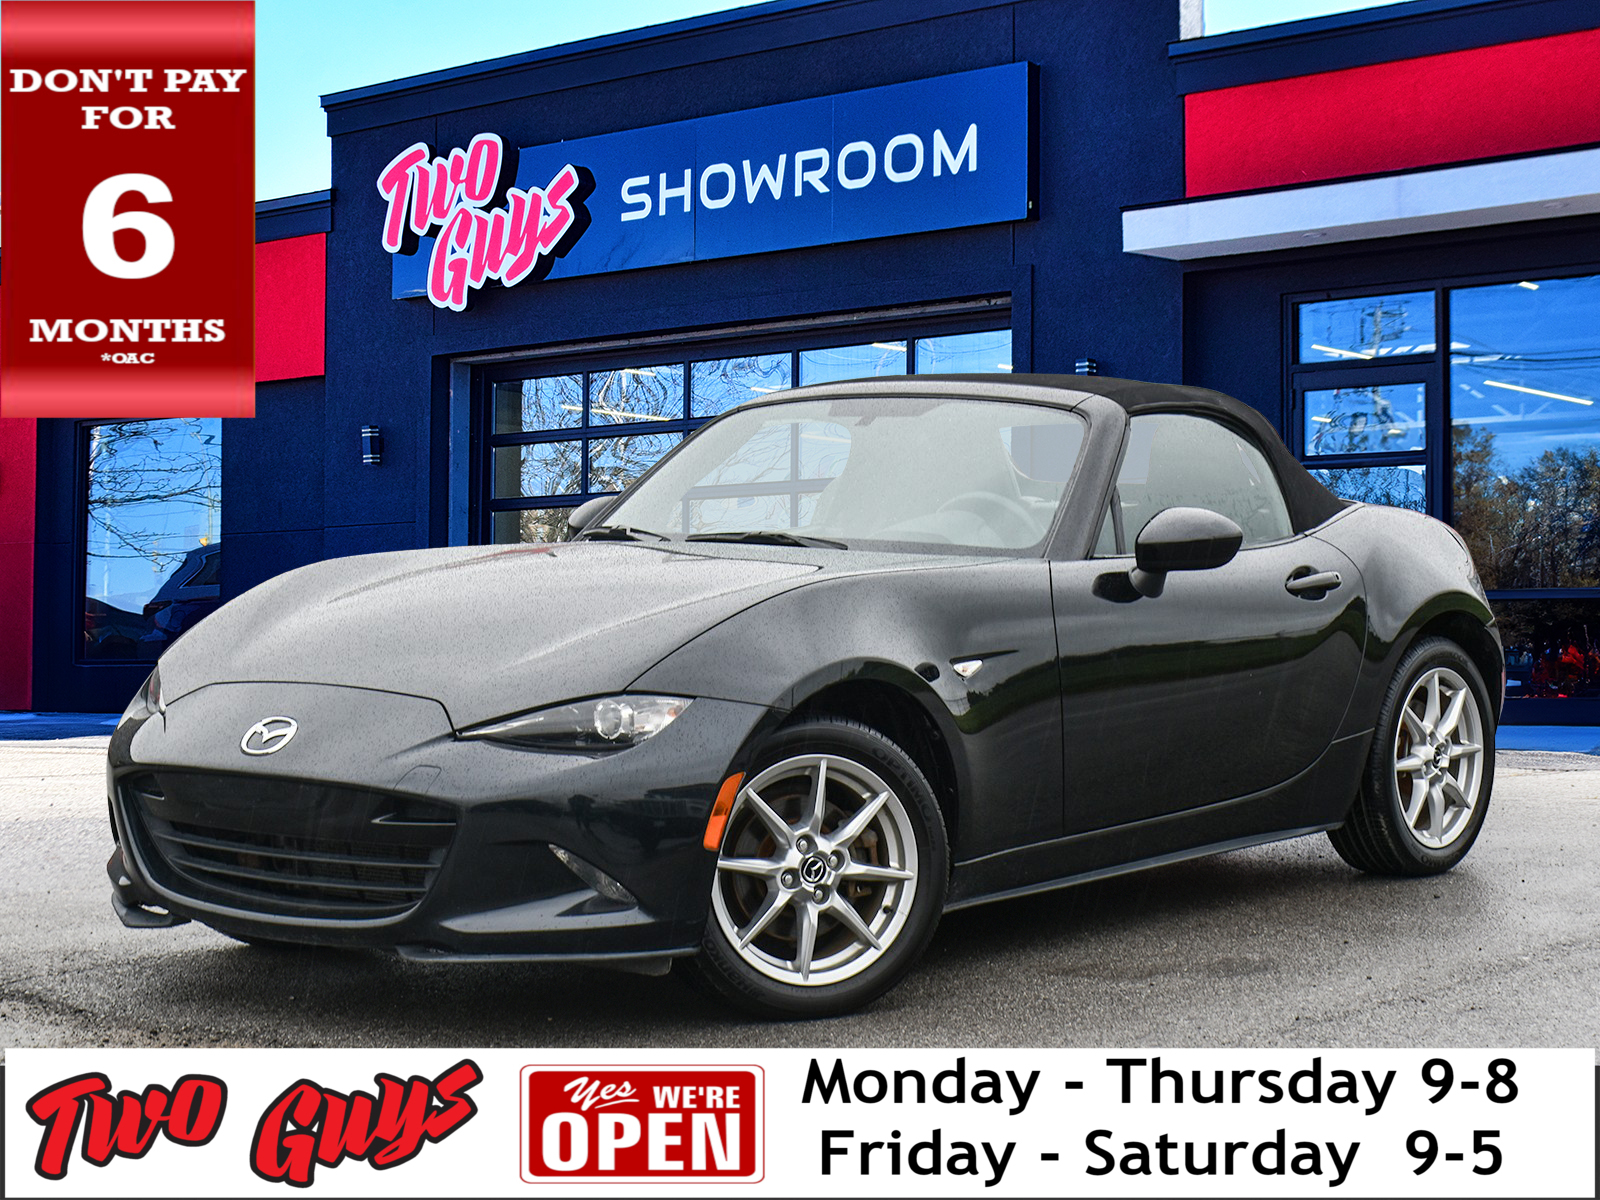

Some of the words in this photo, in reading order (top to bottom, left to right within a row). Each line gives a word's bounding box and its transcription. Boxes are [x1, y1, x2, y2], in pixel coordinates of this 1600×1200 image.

[377, 132, 504, 254] Two
[620, 123, 978, 222] SHOWROOM
[427, 164, 580, 312] Guys
